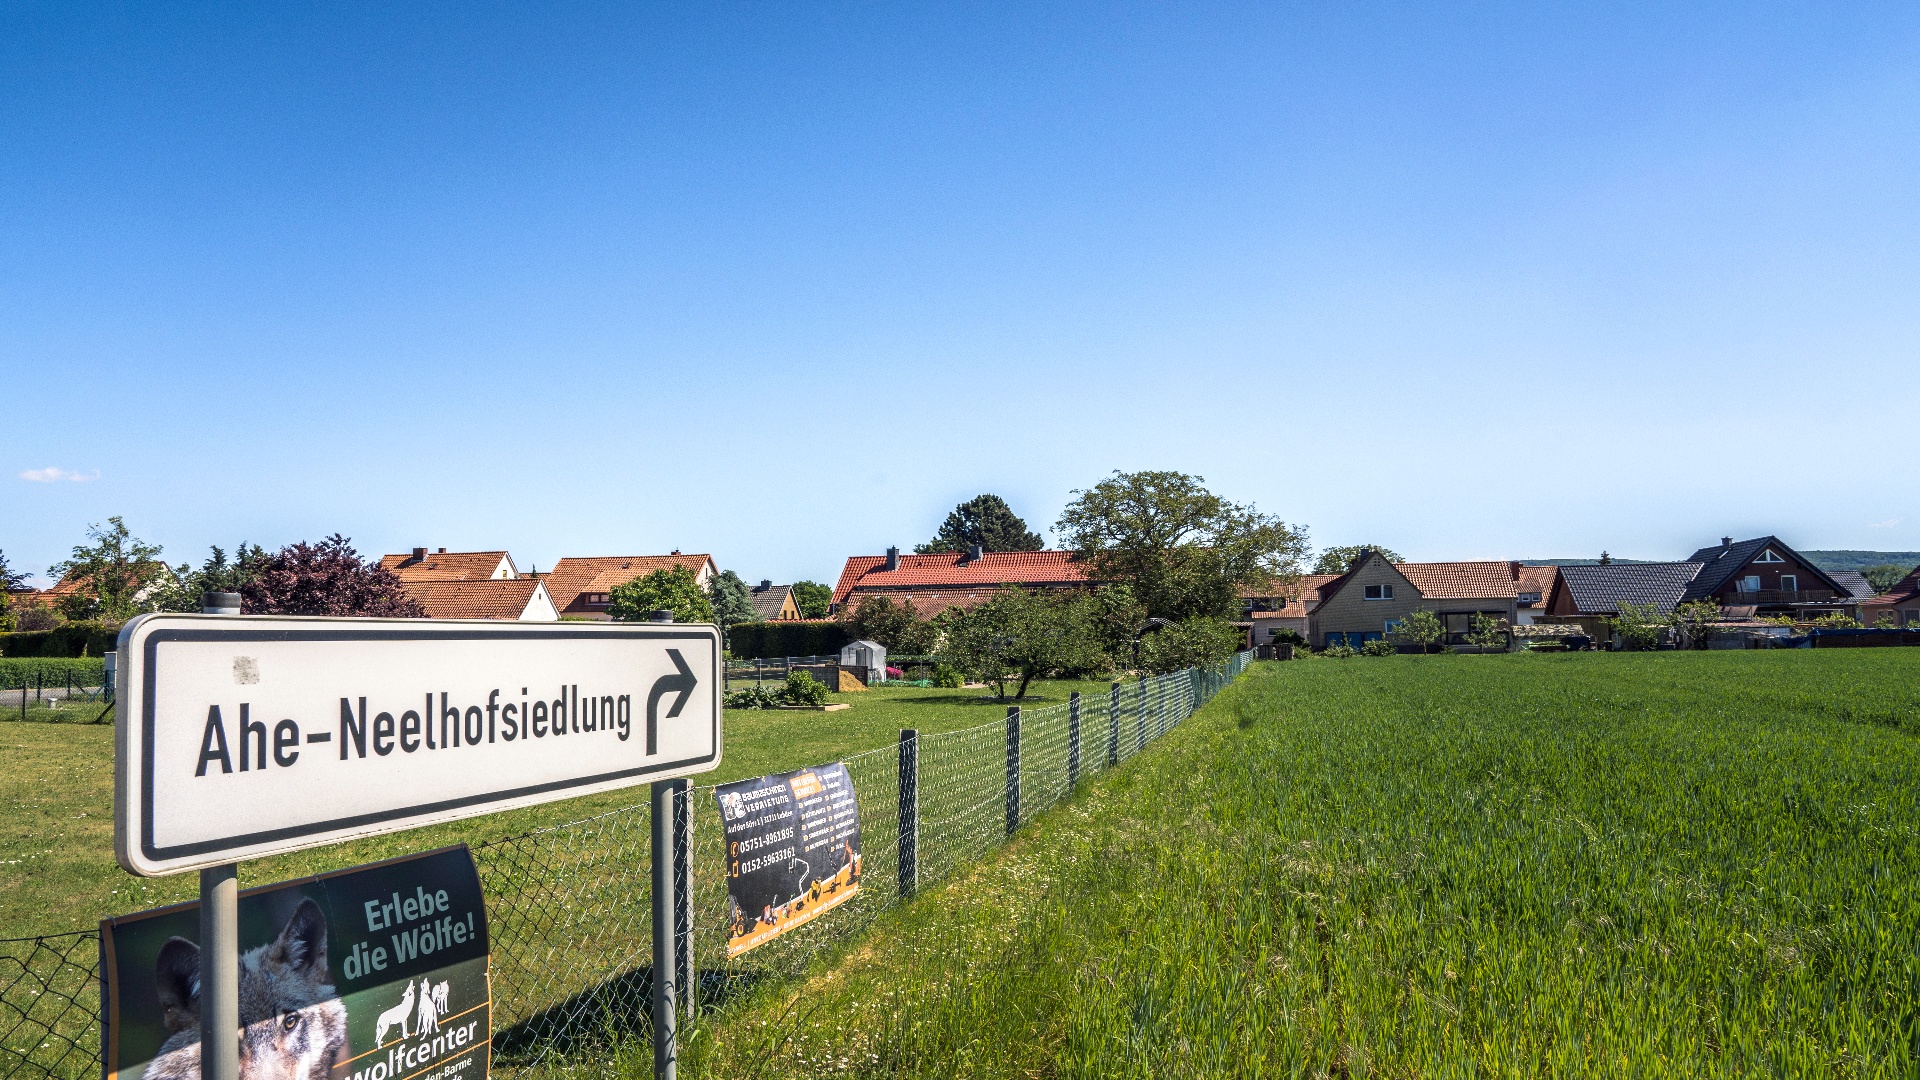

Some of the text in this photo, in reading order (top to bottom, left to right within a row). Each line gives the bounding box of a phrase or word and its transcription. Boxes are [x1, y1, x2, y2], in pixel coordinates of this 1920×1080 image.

[195, 685, 631, 777] Ahe-Neelhofsiedlung
[740, 827, 794, 853] 05751-8961895
[741, 846, 796, 874] 0152-59633161
[364, 886, 449, 932] Erlebe
[343, 911, 475, 980] die Wölfe!
